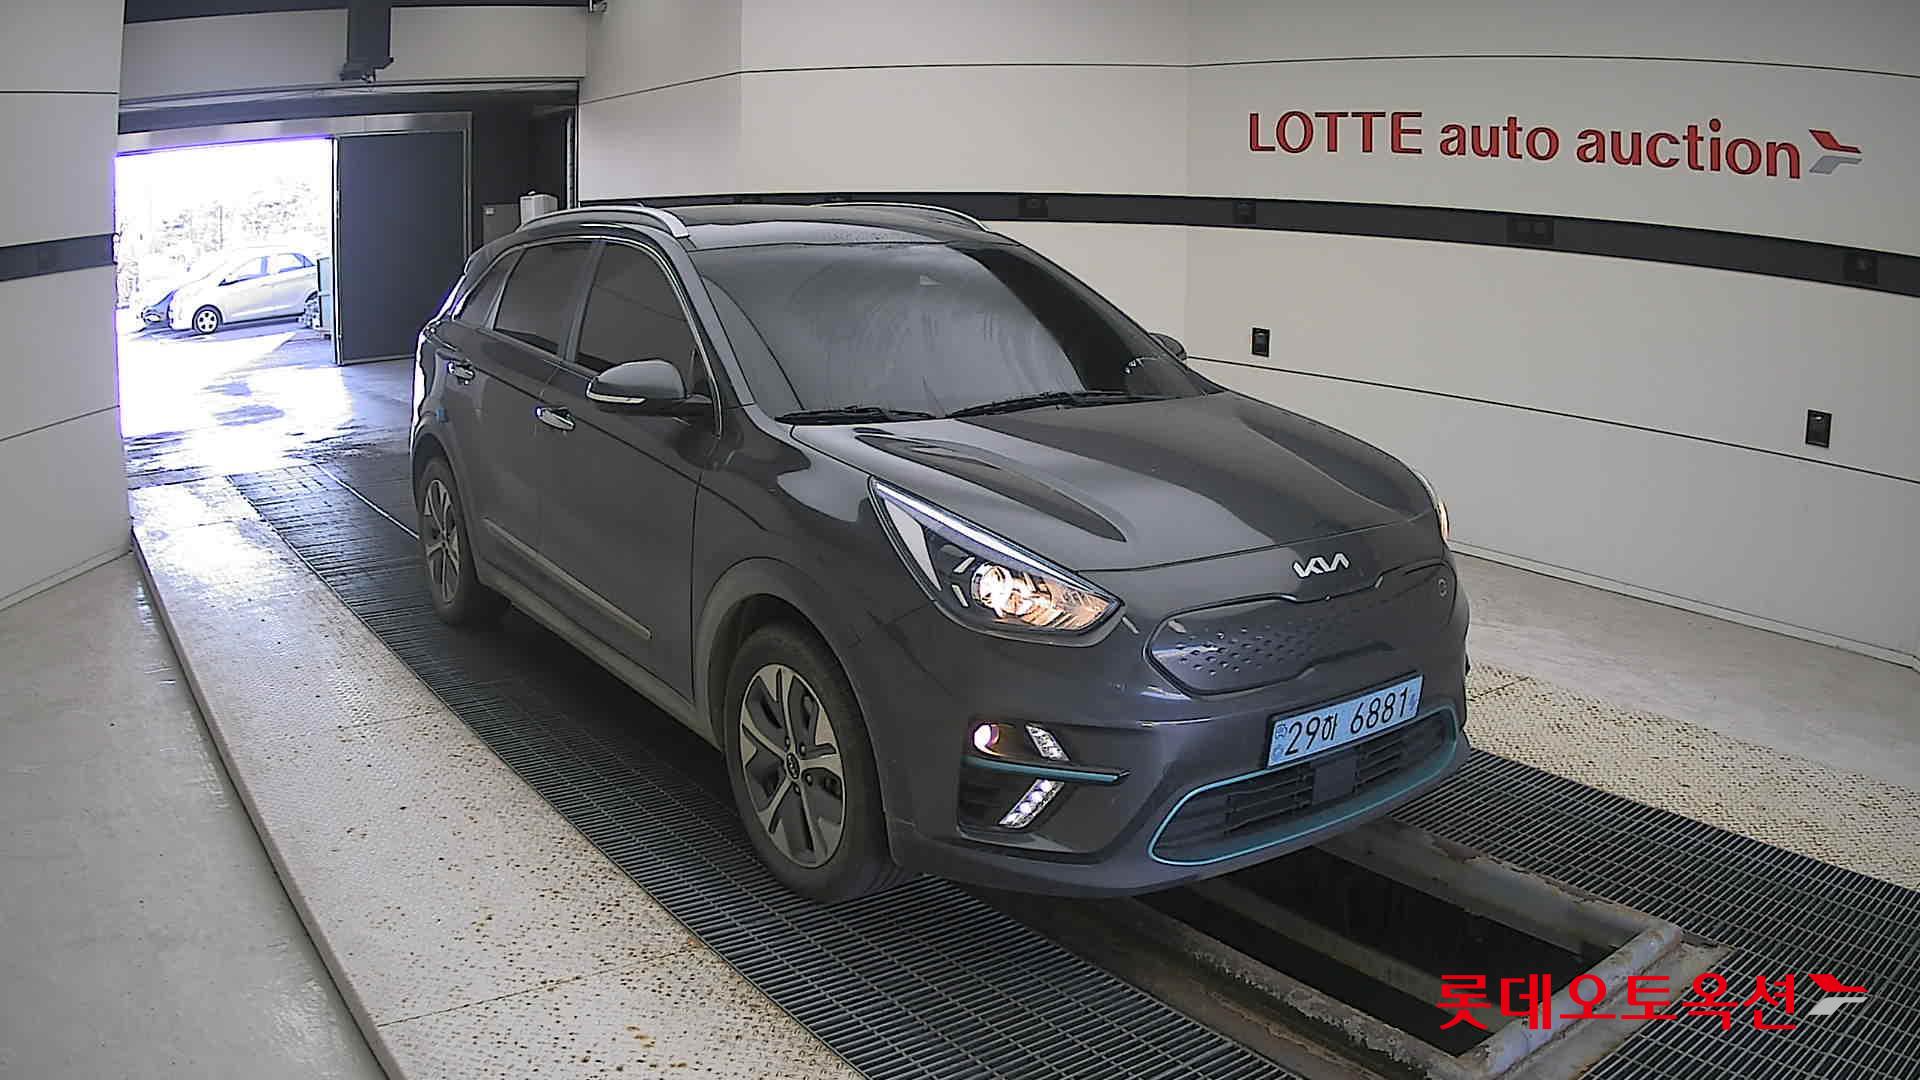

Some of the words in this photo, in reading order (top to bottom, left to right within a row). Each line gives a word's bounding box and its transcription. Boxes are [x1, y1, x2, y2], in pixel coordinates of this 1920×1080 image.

[1248, 111, 1424, 154] LOTTE
[1440, 116, 1560, 161] auto
[1576, 118, 1801, 180] auction
[1284, 713, 1338, 756] 29하
[1350, 687, 1409, 734] 6881
